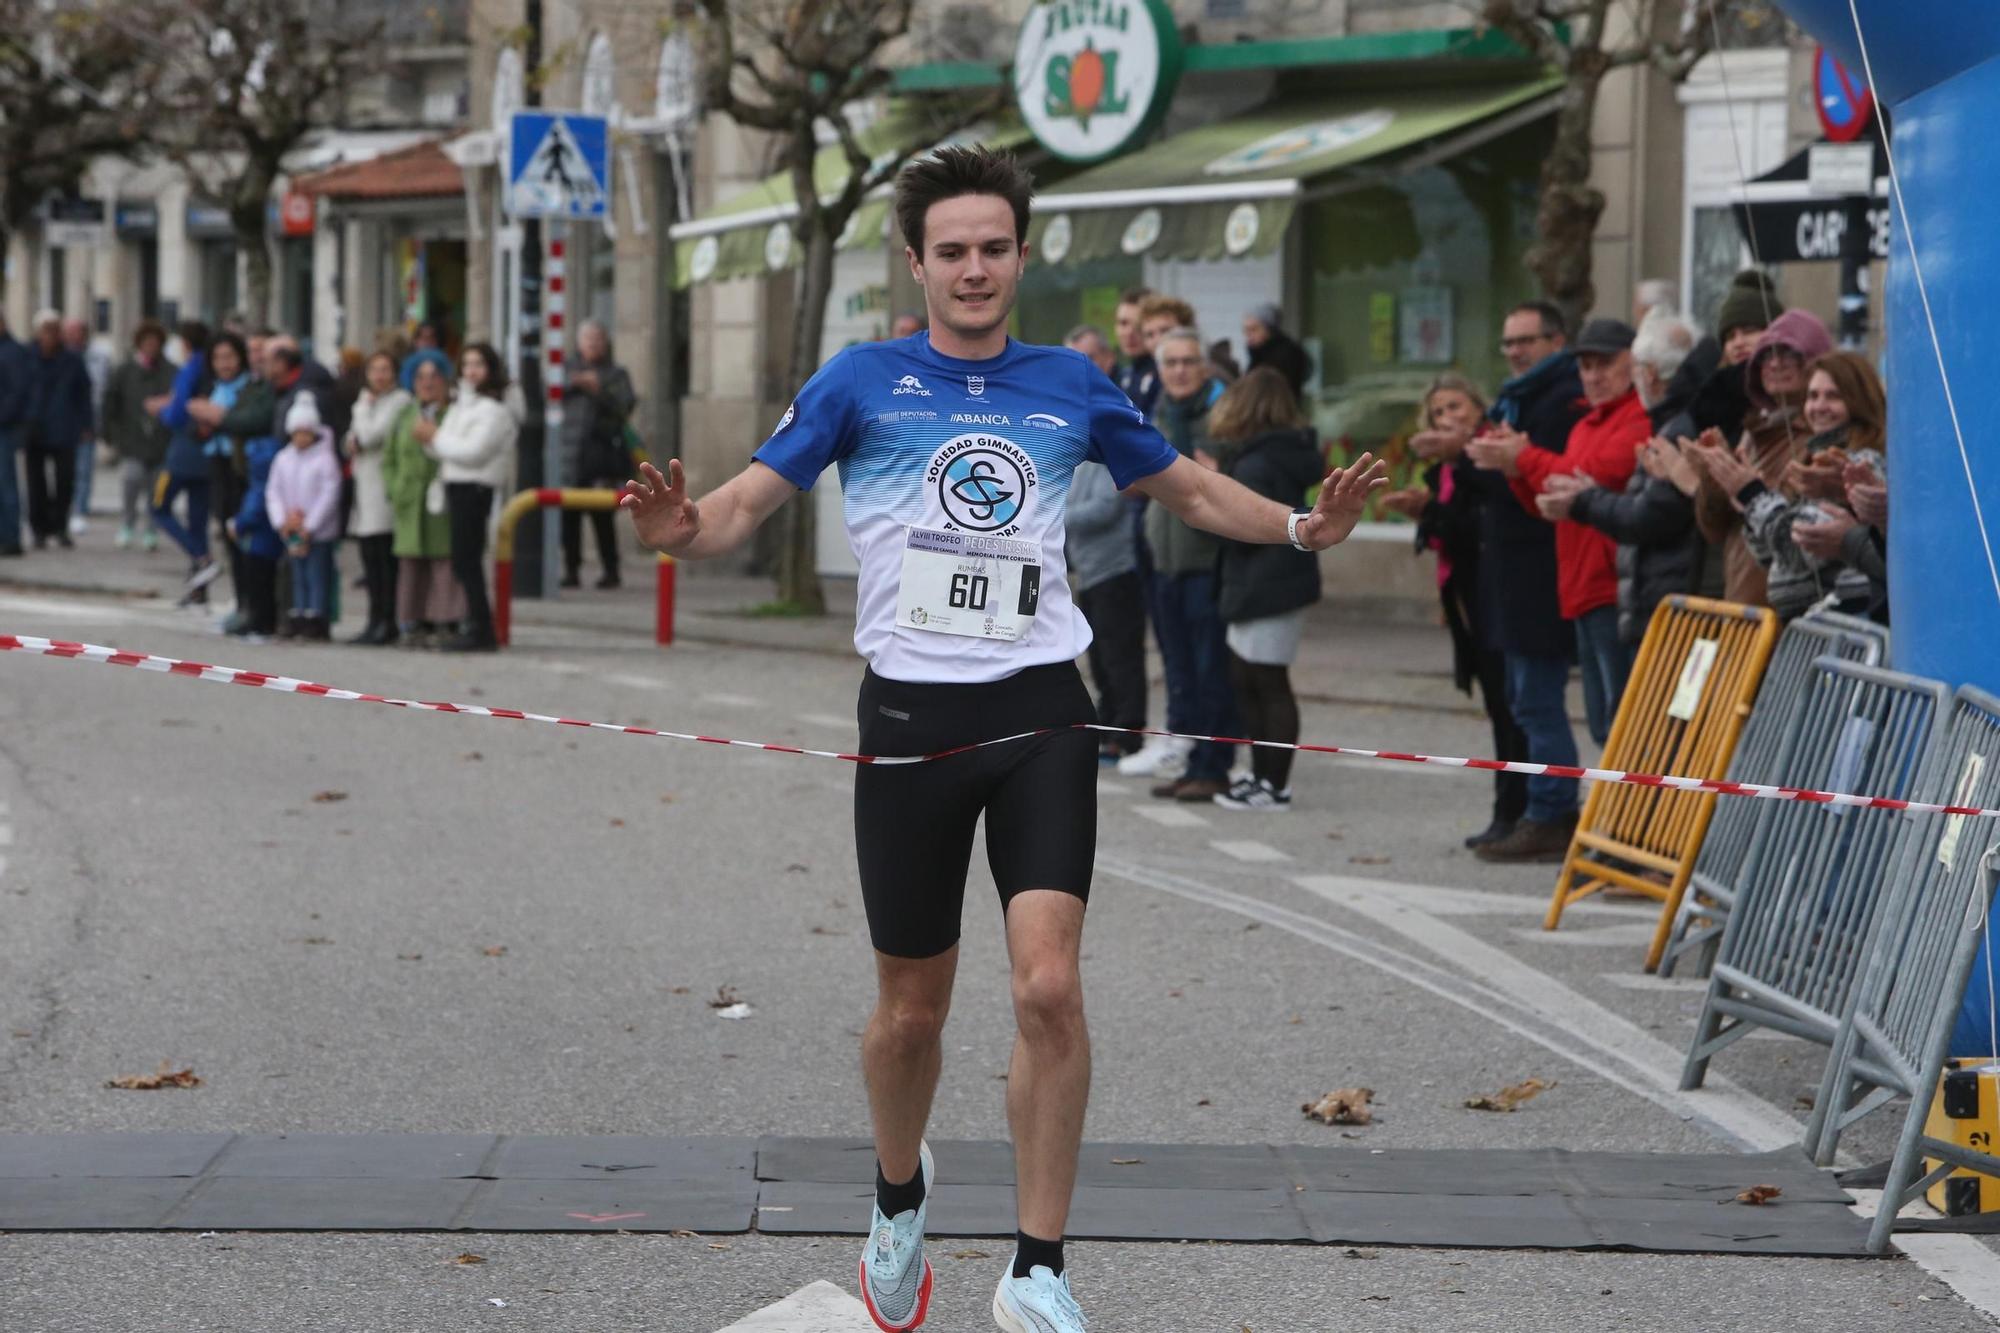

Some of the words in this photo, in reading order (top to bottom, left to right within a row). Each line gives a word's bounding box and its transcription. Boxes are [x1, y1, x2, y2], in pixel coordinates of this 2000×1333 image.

[1045, 49, 1130, 118] SOL
[928, 440, 973, 484] SOCIEDAD
[911, 531, 931, 540] XLVIII
[932, 533, 961, 545] TROFEO
[966, 551, 995, 559] MEMORIAL
[1010, 555, 1036, 563] CORDEIRO
[949, 573, 989, 610] 60
